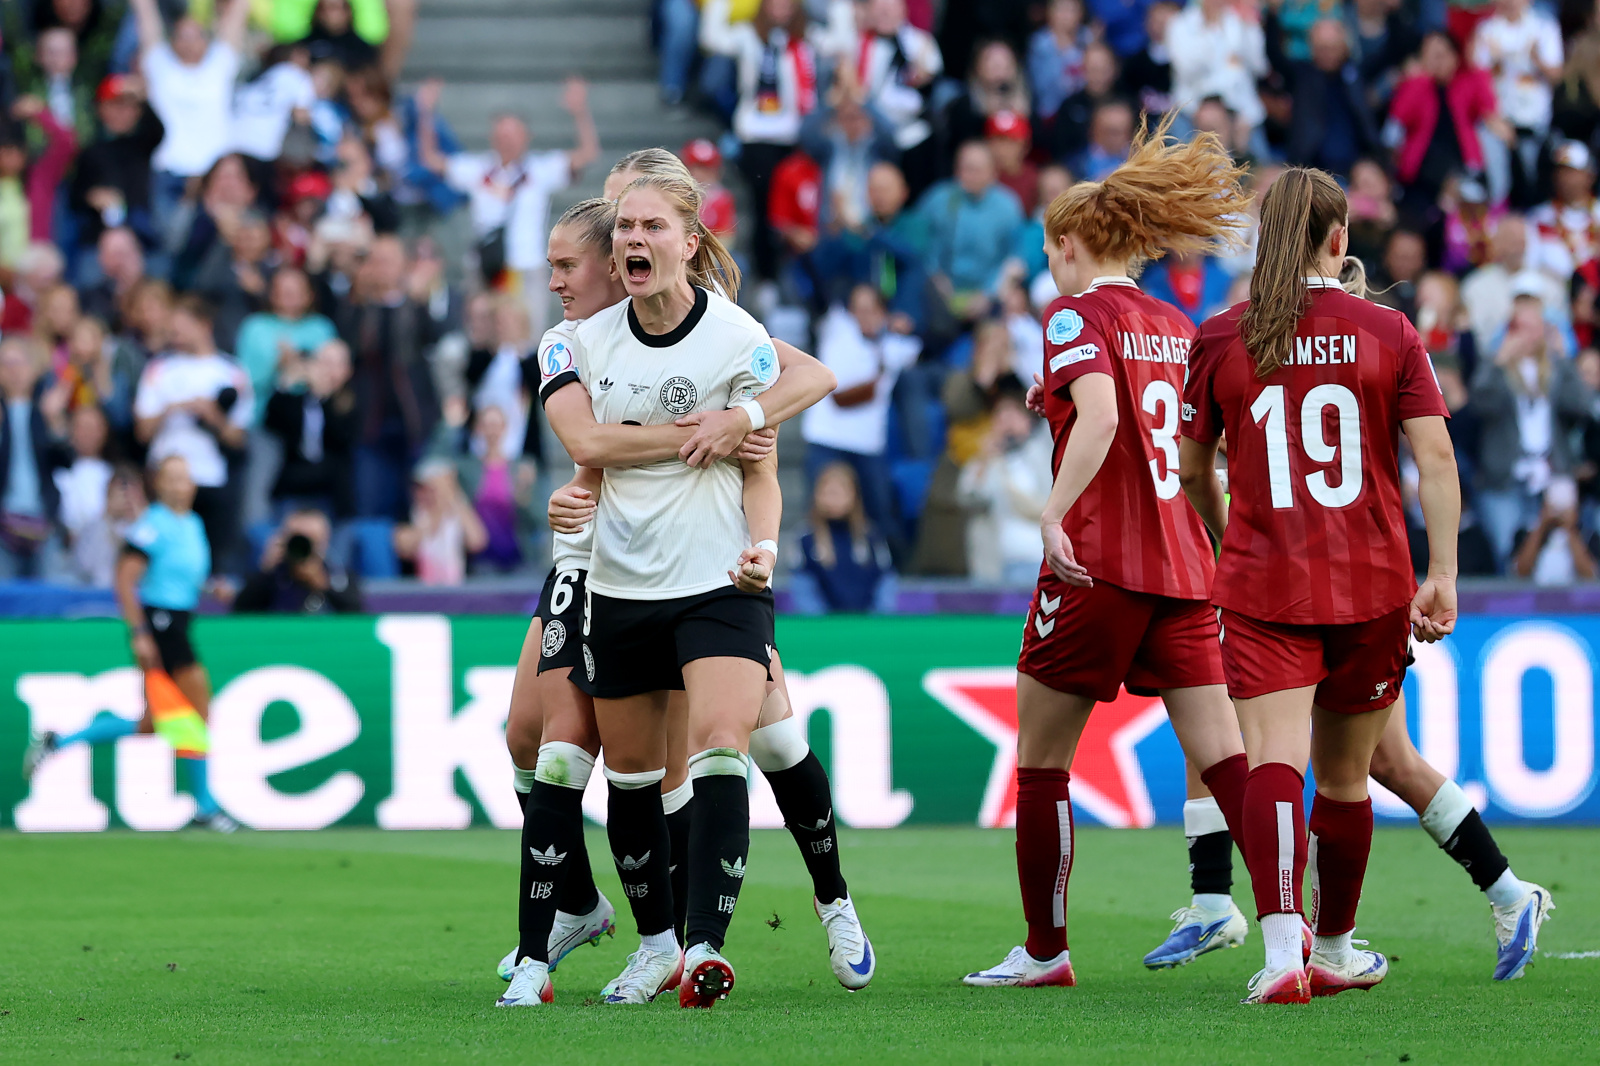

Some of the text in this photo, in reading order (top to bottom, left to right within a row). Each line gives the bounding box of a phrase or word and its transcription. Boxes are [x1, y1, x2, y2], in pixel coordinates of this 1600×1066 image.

[1117, 331, 1190, 364] ALLISAGE
[1283, 335, 1356, 365] MSEN
[1142, 380, 1181, 500] 3
[1250, 383, 1363, 509] 19
[550, 569, 579, 616] 6
[14, 615, 913, 831] nekn
[1281, 869, 1292, 909] DANMARK
